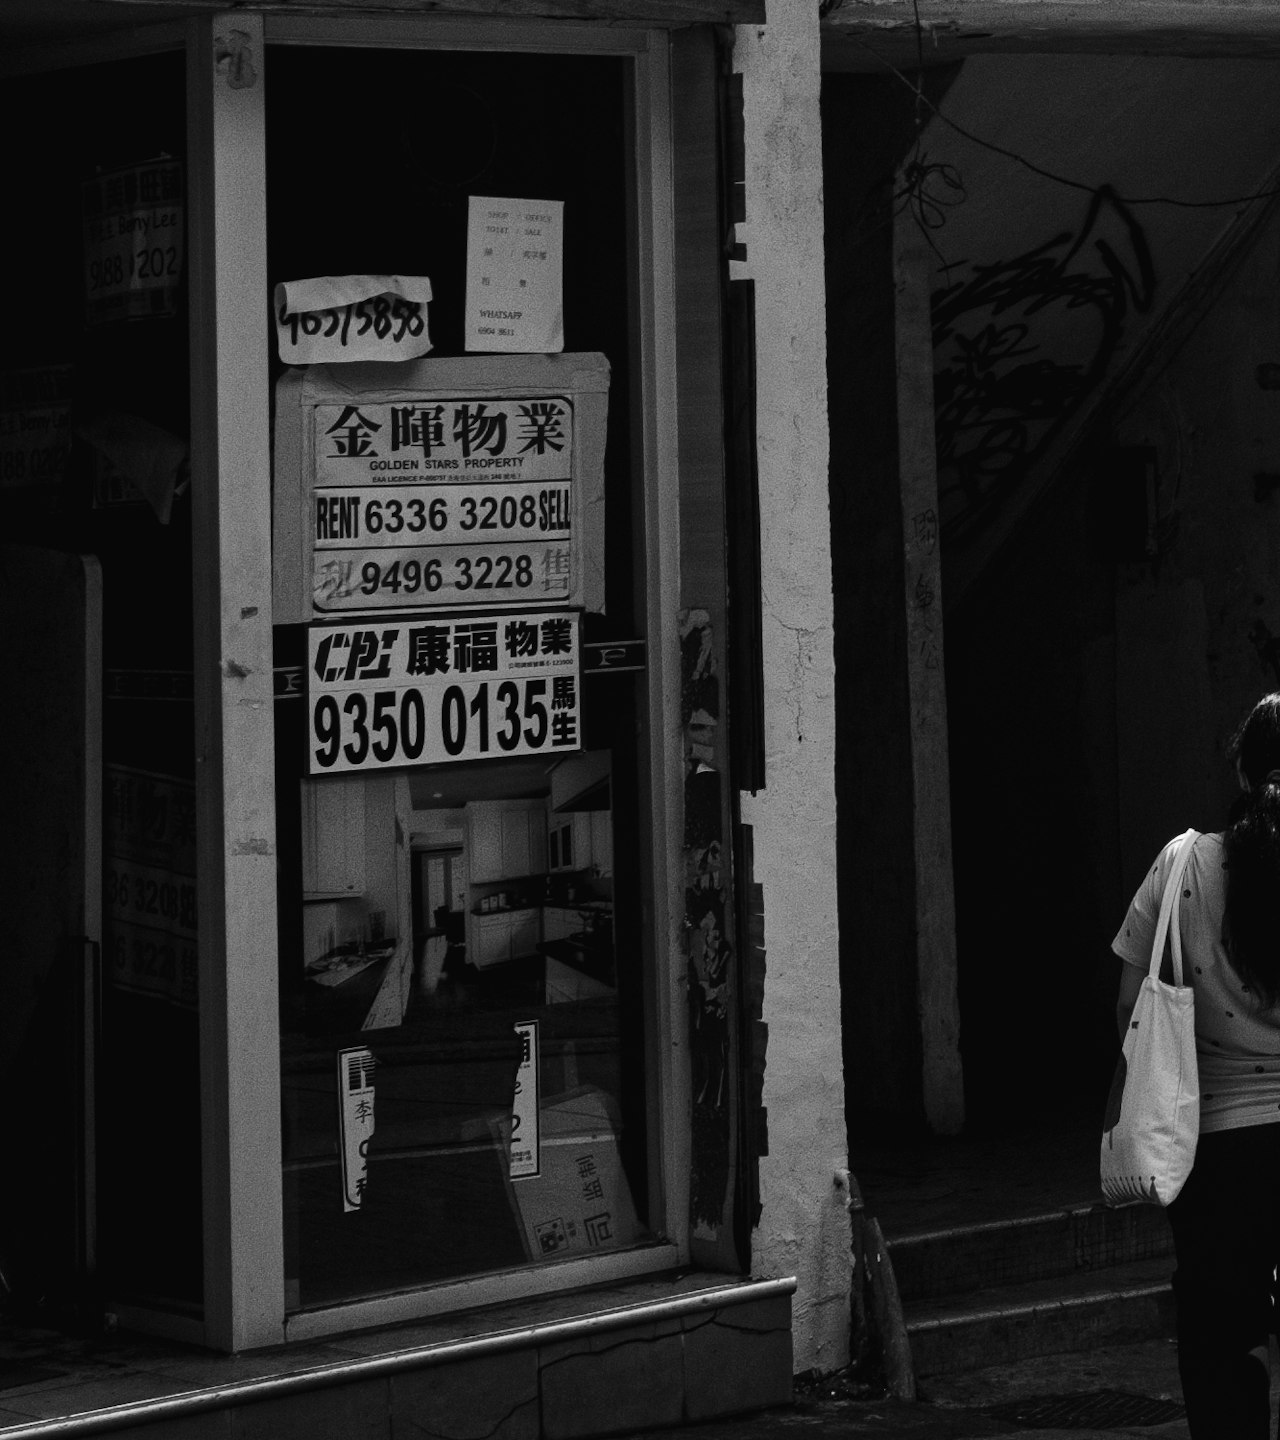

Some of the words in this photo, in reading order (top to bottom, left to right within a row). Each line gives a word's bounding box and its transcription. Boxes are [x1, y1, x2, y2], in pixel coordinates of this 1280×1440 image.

[153, 211, 178, 229] Lee
[479, 310, 523, 320] WHATSAPP
[325, 402, 566, 458] 金暉物業
[369, 460, 419, 471] GOLDEN
[424, 458, 459, 469] STARS
[464, 457, 525, 469] PROPERTY
[316, 496, 361, 540] RENT
[365, 499, 448, 534] 6336
[459, 495, 536, 531] 3208
[539, 489, 571, 532] SELL
[360, 559, 443, 595] 9496
[454, 555, 533, 591] 3228
[406, 622, 498, 675] 康福
[504, 618, 573, 657] 物業
[314, 688, 425, 768] 9350
[441, 679, 549, 756] 0135
[551, 676, 577, 746] 馬生
